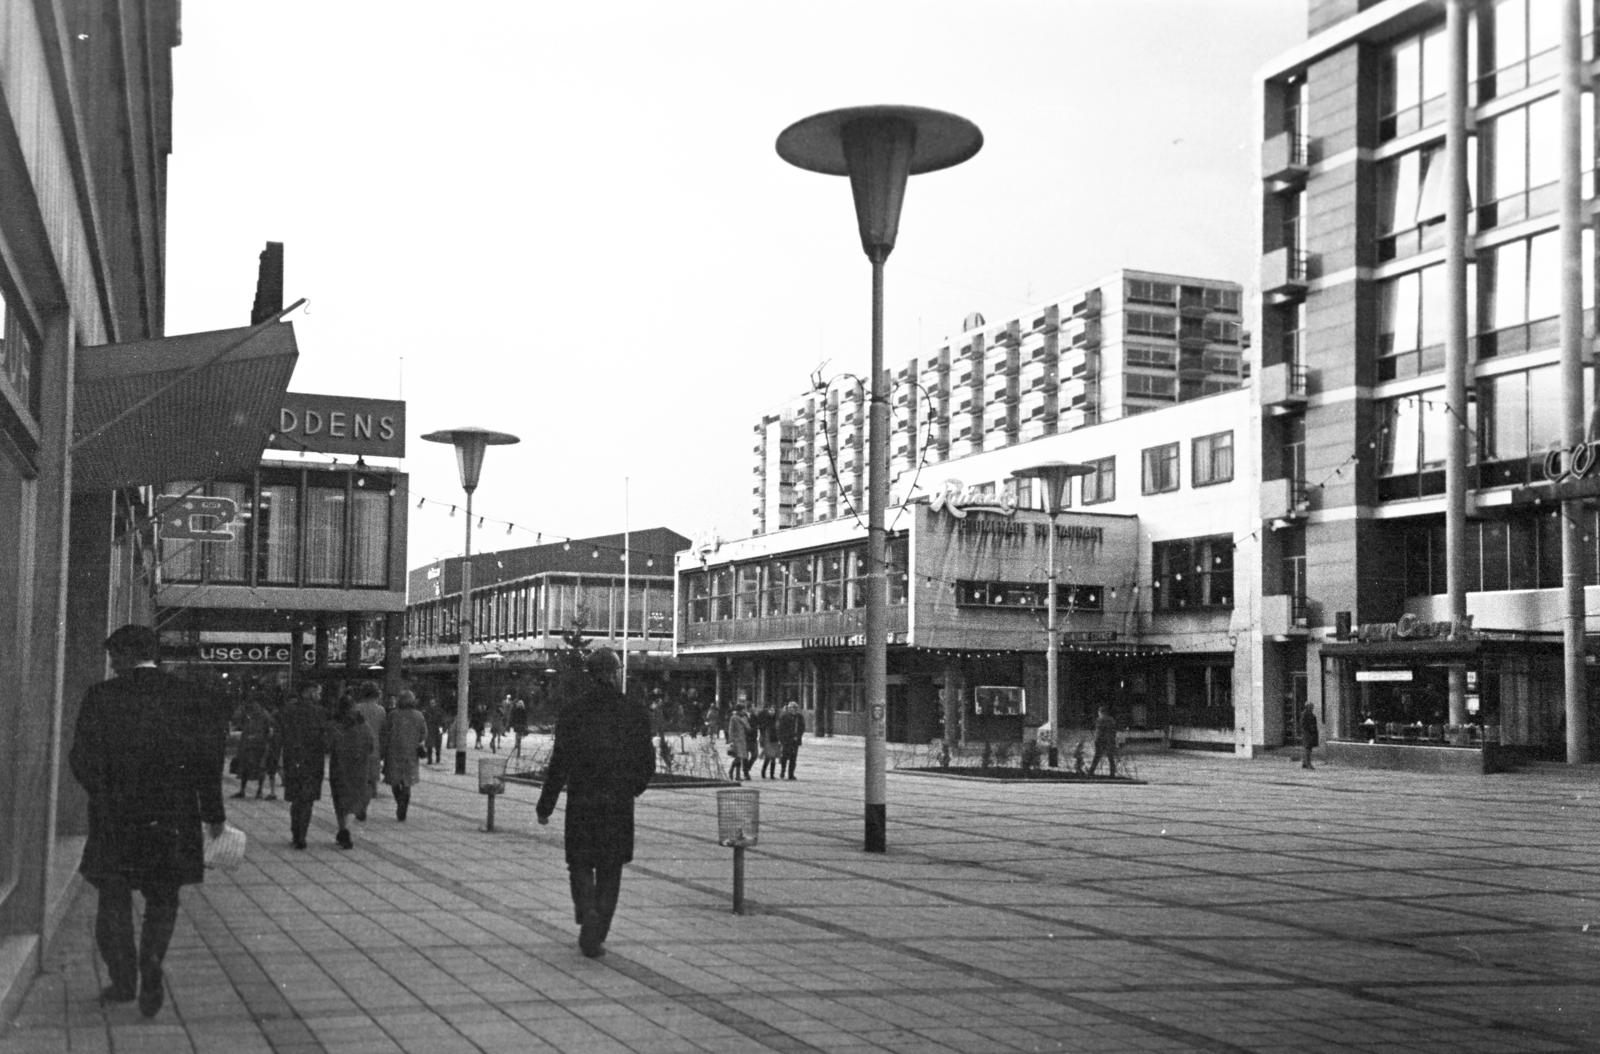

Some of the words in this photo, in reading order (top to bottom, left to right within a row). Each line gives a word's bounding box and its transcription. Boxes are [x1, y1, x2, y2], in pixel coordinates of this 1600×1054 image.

[958, 517, 1028, 539] POMENADE
[1034, 522, 1104, 543] RETAURANT
[248, 645, 272, 661] of
